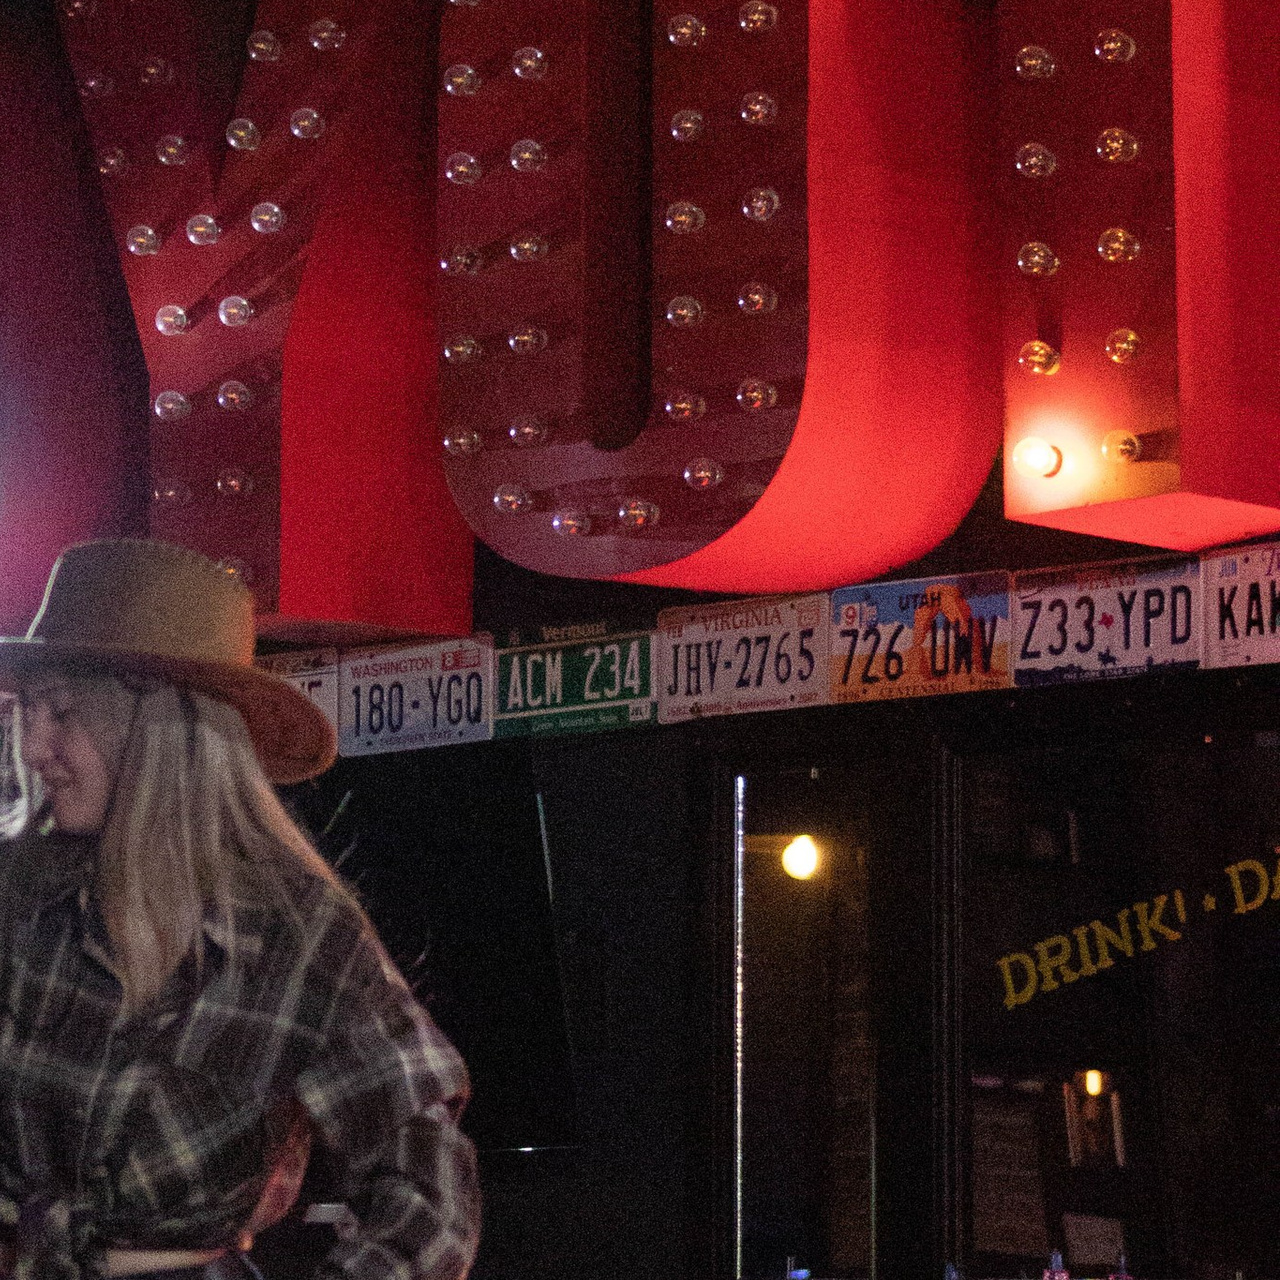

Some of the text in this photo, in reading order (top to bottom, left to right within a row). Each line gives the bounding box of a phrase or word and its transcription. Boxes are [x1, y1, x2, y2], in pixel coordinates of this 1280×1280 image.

[899, 590, 942, 611] UTAH
[541, 621, 608, 641] Vermont
[701, 607, 783, 633] VIRGINIA
[351, 656, 434, 679] WASHINGTON
[839, 625, 905, 686] 726
[506, 639, 641, 711] ACM 234
